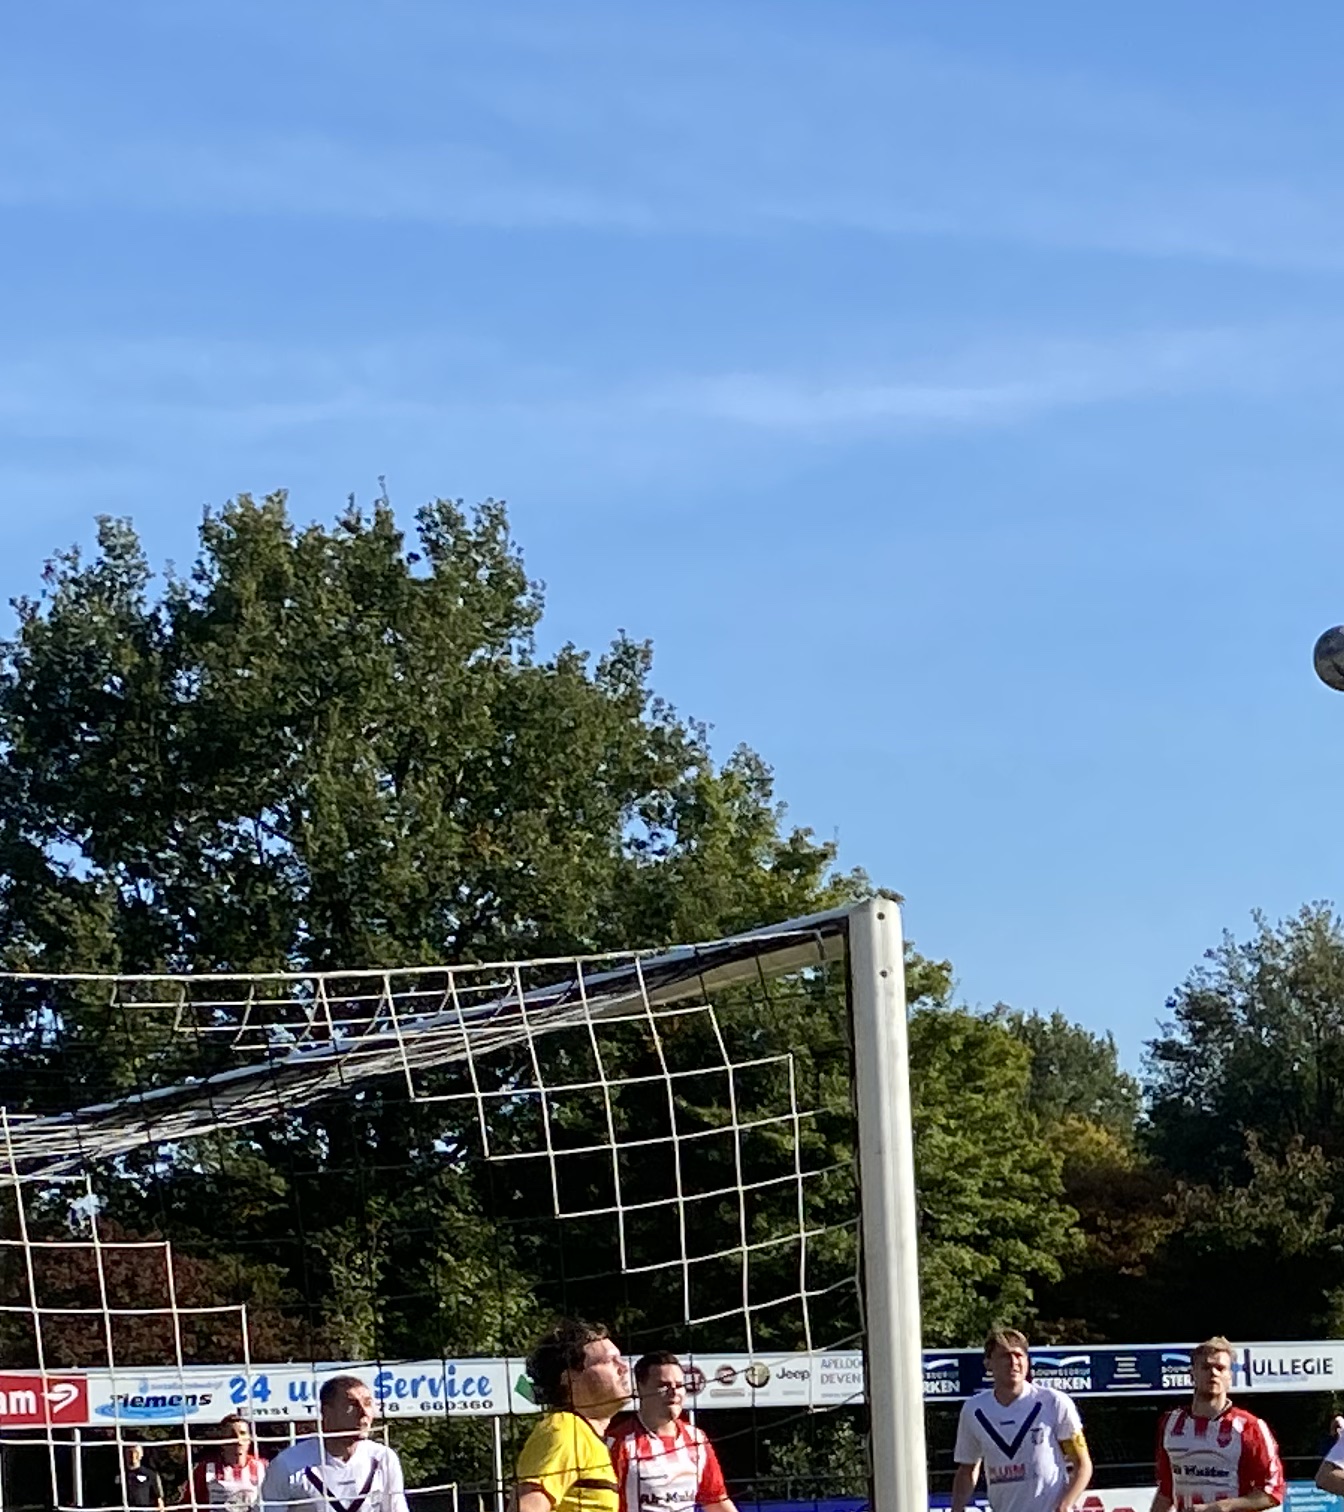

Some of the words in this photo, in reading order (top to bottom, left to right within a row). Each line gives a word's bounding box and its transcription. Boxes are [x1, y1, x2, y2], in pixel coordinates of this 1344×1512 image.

[229, 1375, 271, 1404] 24
[373, 1364, 493, 1399] Service
[776, 1367, 811, 1380] Jeep
